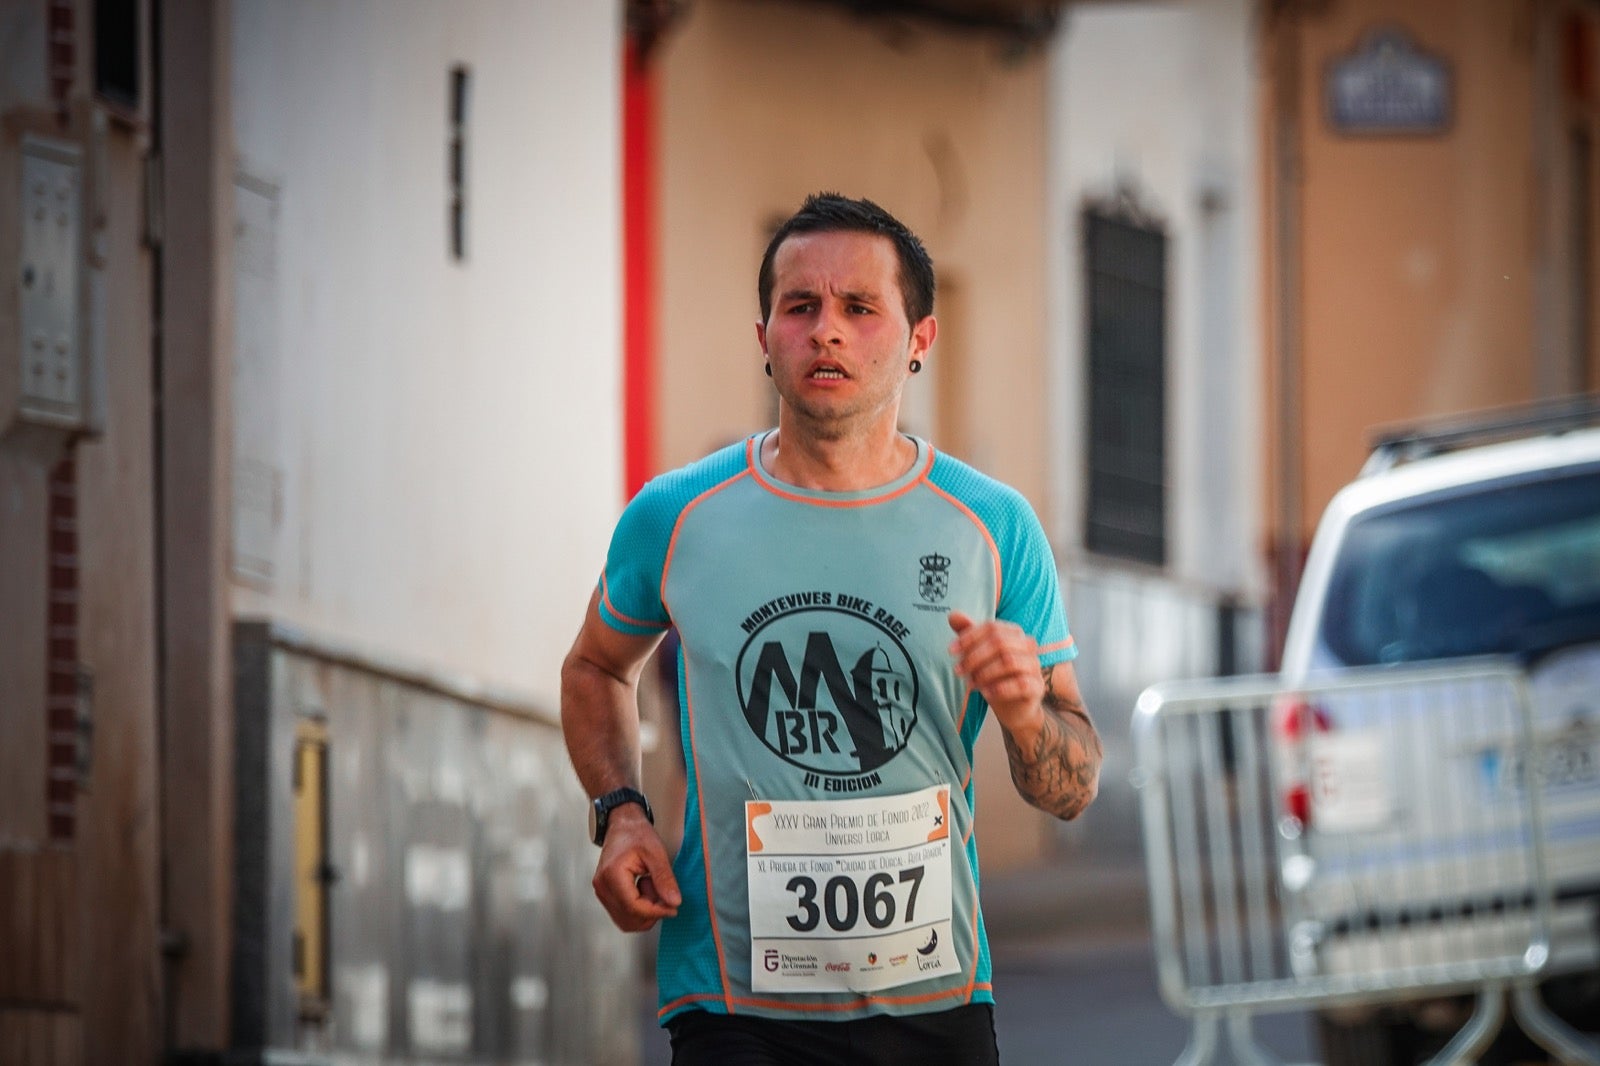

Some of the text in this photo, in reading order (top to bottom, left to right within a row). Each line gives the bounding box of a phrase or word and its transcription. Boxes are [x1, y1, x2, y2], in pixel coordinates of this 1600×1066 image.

[740, 591, 832, 634] MONTEVIVES
[836, 593, 874, 615] BIKE
[803, 772, 882, 792] III EDICION
[773, 813, 799, 830] XXXV
[911, 801, 930, 821] 2022
[785, 864, 925, 933] 3067
